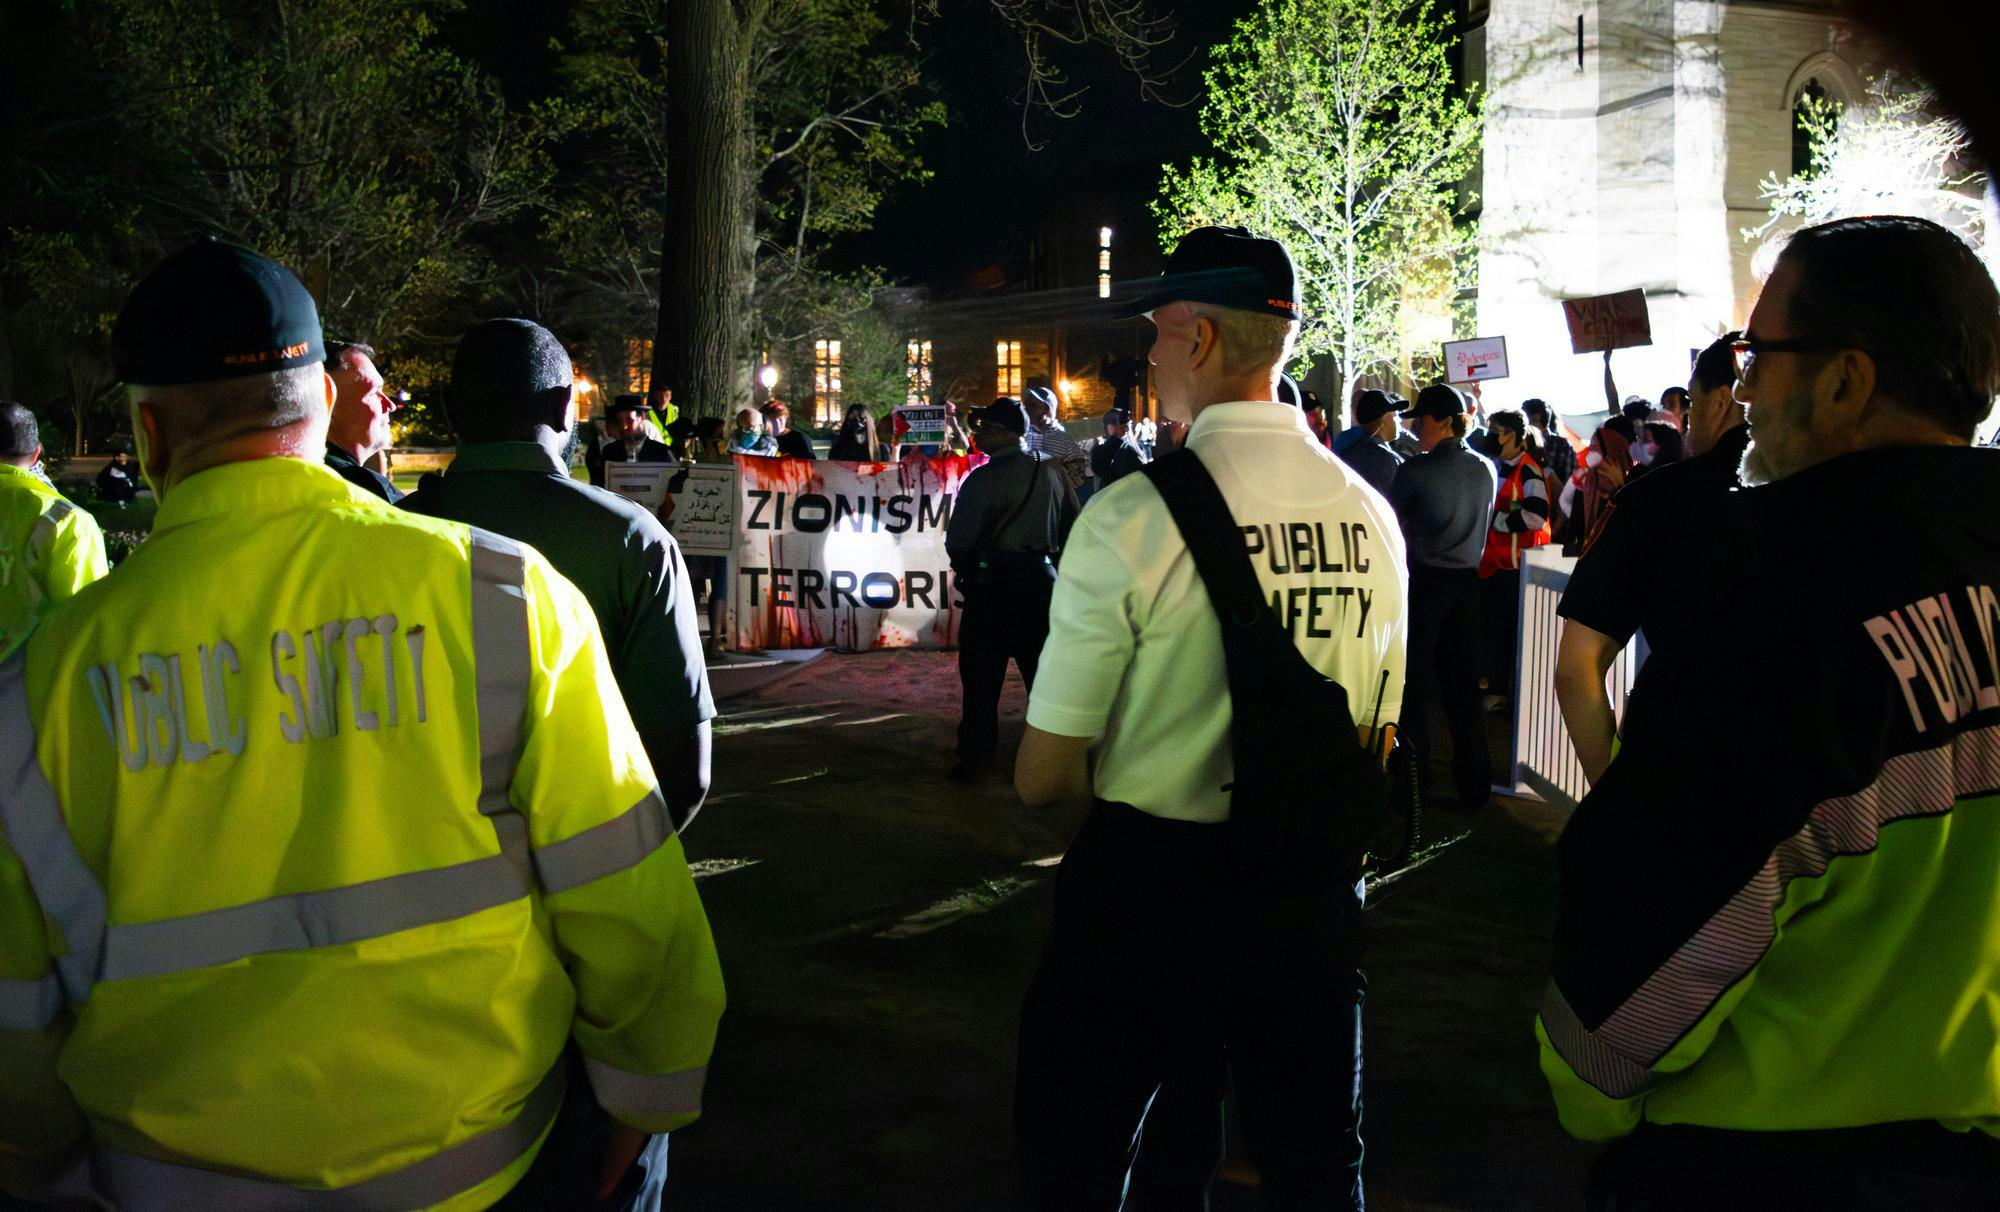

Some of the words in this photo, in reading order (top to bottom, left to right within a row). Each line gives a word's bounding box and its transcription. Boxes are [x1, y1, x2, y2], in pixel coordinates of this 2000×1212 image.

[747, 490, 952, 534] ZIONISM
[1240, 522, 1370, 575] PUBLIC
[740, 567, 964, 610] TERRORI
[1271, 587, 1373, 638] AFETY
